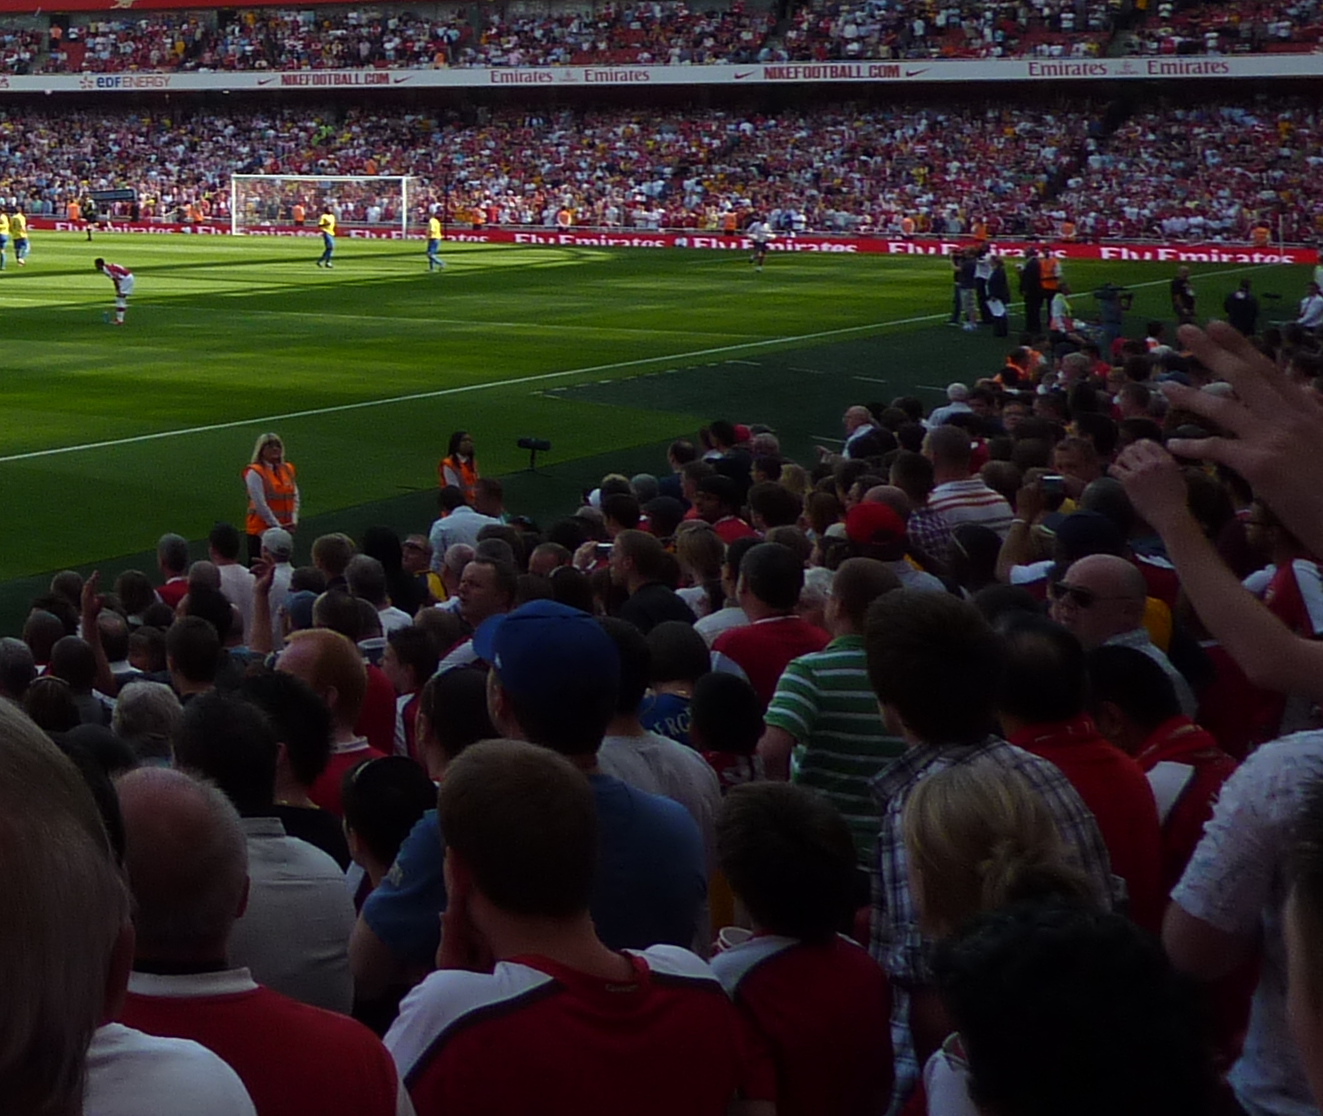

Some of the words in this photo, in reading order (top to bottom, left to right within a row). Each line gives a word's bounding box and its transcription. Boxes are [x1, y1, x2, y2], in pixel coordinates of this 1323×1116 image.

[764, 65, 900, 79] NIKEFOOTBALL.COM
[1028, 60, 1108, 77] Emirates
[1147, 58, 1229, 75] Emirates
[281, 73, 389, 86] NIKEFOOTBALL.COM
[490, 69, 553, 84] Emirates
[584, 68, 650, 83] Emirates
[515, 233, 554, 246] Fly
[560, 234, 665, 248] Emirates
[693, 237, 737, 249] Fly
[888, 241, 936, 255] Fly
[1100, 247, 1151, 260] Fly
[1157, 248, 1295, 264] Emirates
